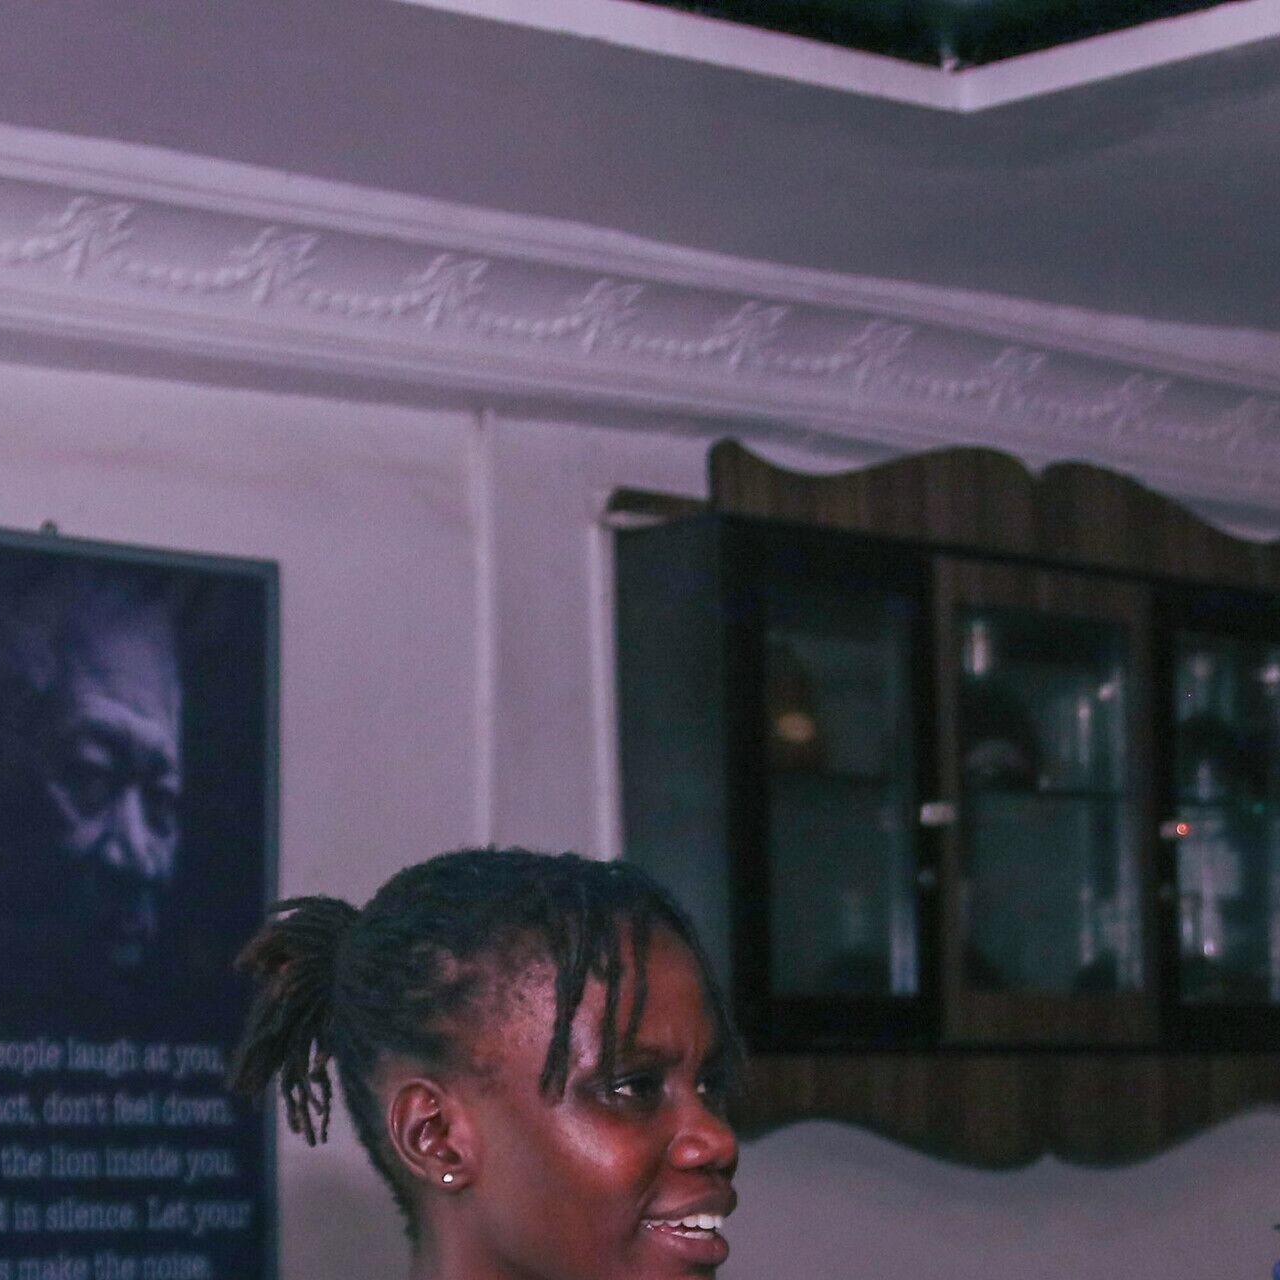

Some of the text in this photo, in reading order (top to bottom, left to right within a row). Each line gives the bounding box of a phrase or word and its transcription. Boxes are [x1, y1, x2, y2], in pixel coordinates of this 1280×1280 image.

[66, 1038, 137, 1079] laugh
[144, 1044, 170, 1071] at
[41, 1090, 107, 1126] don't
[112, 1091, 157, 1126] feel
[0, 1145, 46, 1178] the
[50, 1144, 98, 1178] lion
[103, 1145, 181, 1178] inside
[14, 1202, 40, 1233] in
[146, 1196, 190, 1231] Let
[192, 1201, 252, 1237] your
